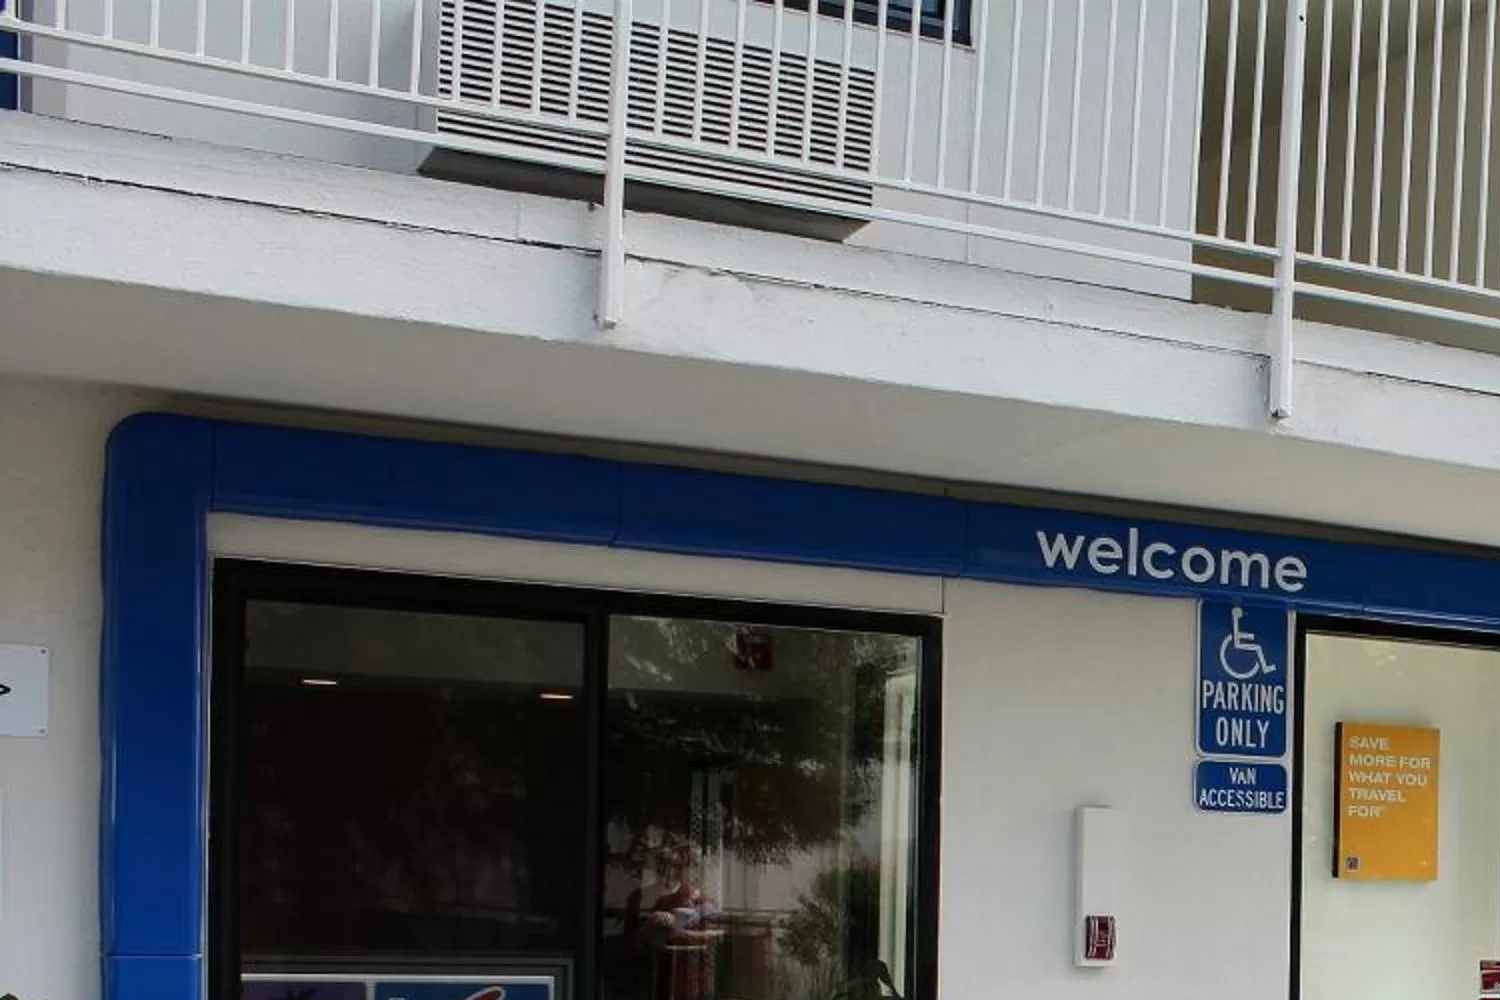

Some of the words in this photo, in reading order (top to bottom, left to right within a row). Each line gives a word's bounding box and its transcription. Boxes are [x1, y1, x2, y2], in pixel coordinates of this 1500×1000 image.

[1036, 527, 1307, 592] welcome
[1202, 680, 1285, 714] PARKING
[1216, 717, 1270, 748] ONLY
[1349, 736, 1389, 750] SAVE
[1349, 753, 1396, 768] MORE
[1399, 756, 1431, 769] FOR
[1229, 767, 1257, 785] VAN
[1348, 771, 1393, 785] WHAT
[1396, 774, 1428, 787] YOU
[1200, 789, 1285, 809] ACCESSIBLE
[1348, 787, 1407, 802] TRAVEL
